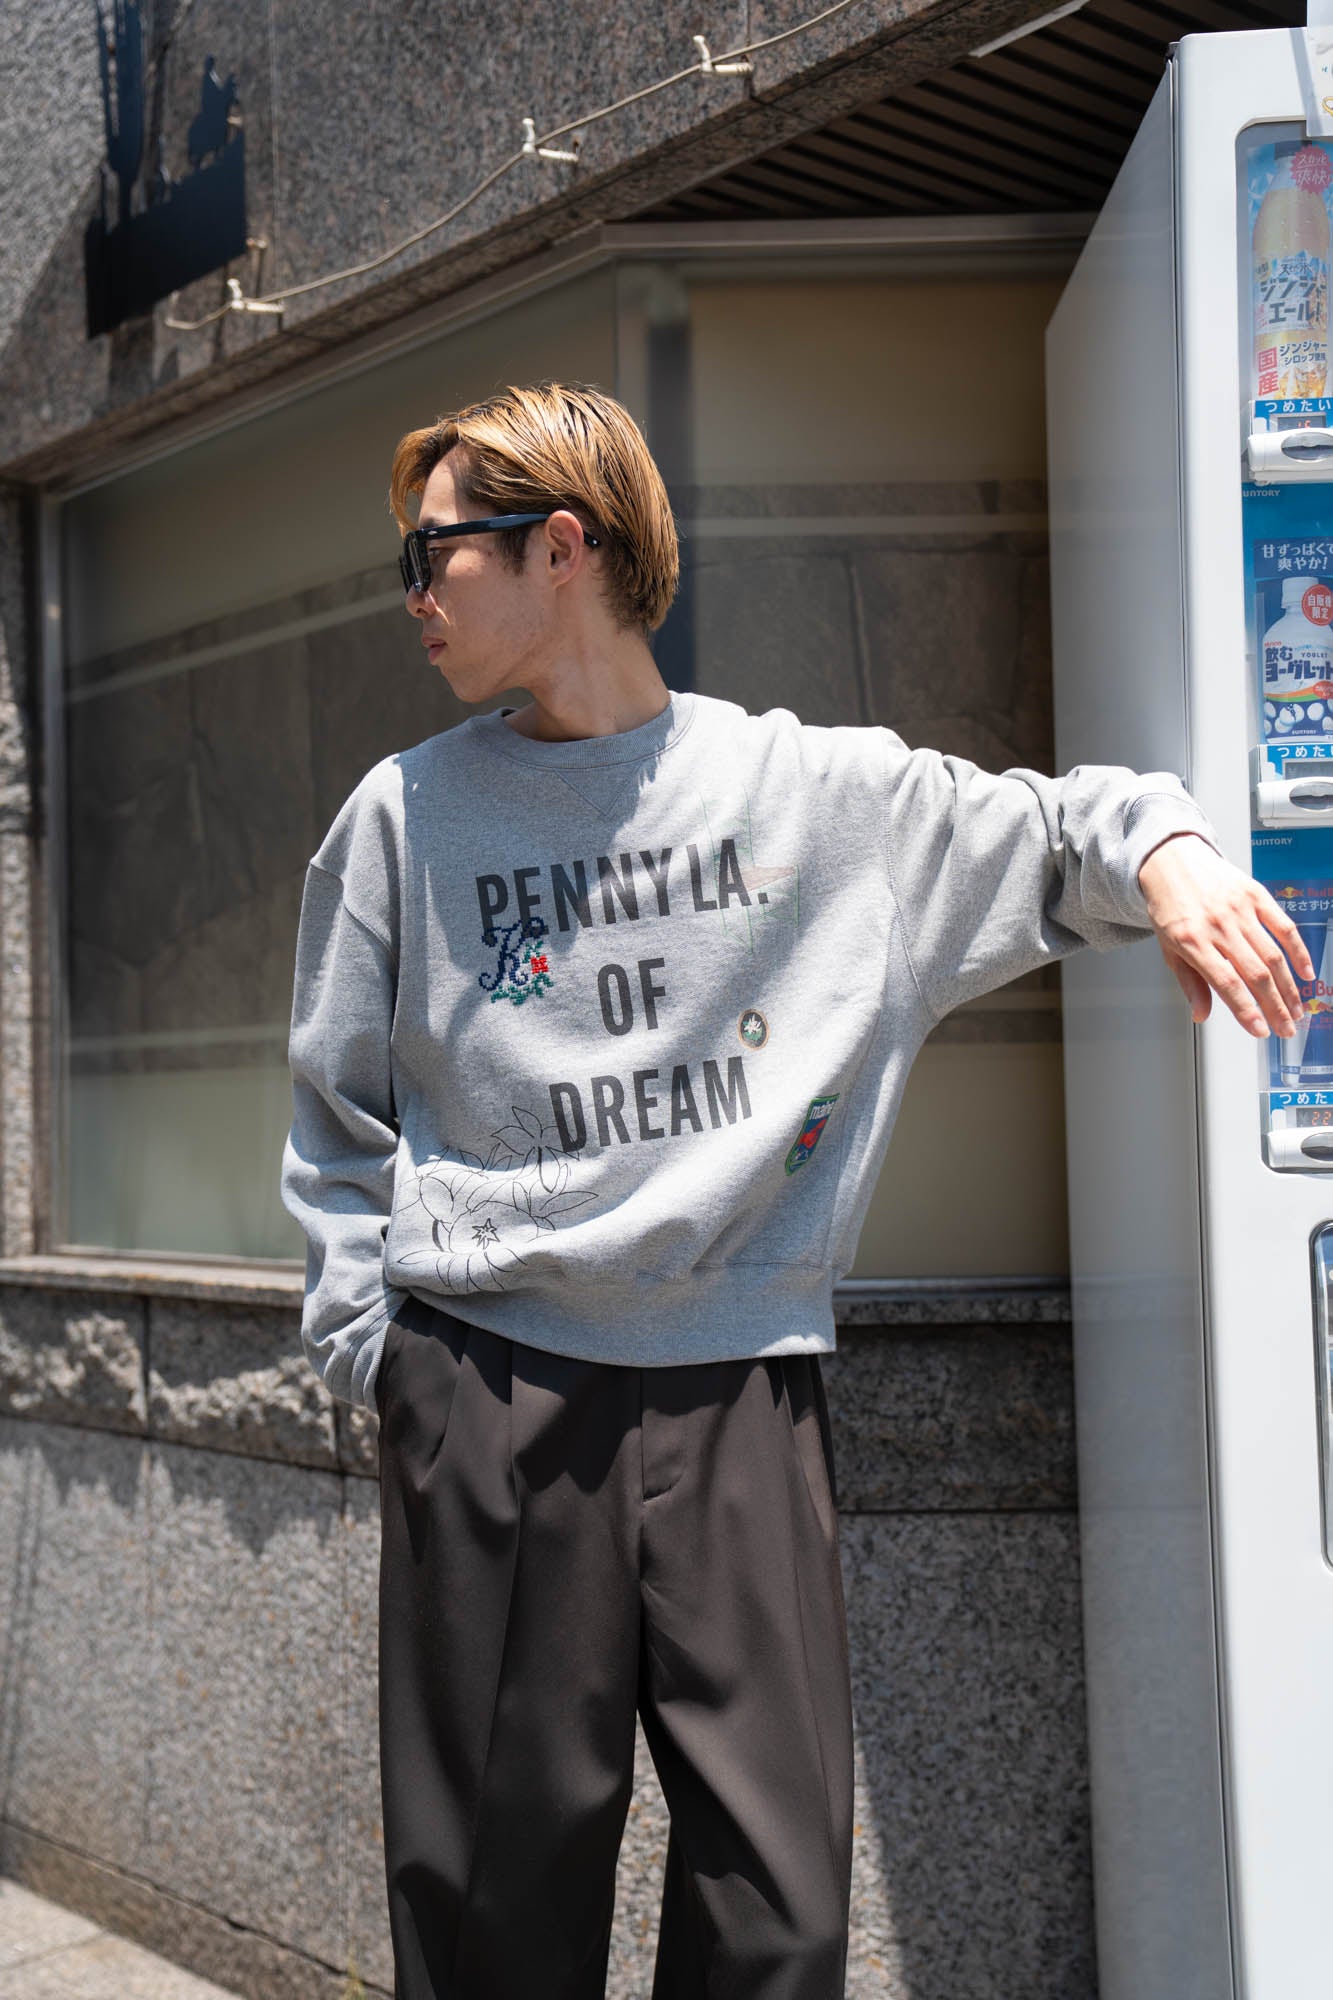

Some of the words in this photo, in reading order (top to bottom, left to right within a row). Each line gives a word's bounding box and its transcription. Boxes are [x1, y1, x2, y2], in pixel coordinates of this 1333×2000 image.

[1280, 340, 1327, 357] ジンジャー
[1258, 347, 1279, 397] 国産
[1265, 400, 1331, 413] つめたい
[1277, 556, 1328, 571] 爽やか!
[1265, 646, 1293, 663] 飲む
[1277, 745, 1333, 758] つめた
[597, 957, 667, 1037] OF
[549, 1056, 752, 1154] DREAM
